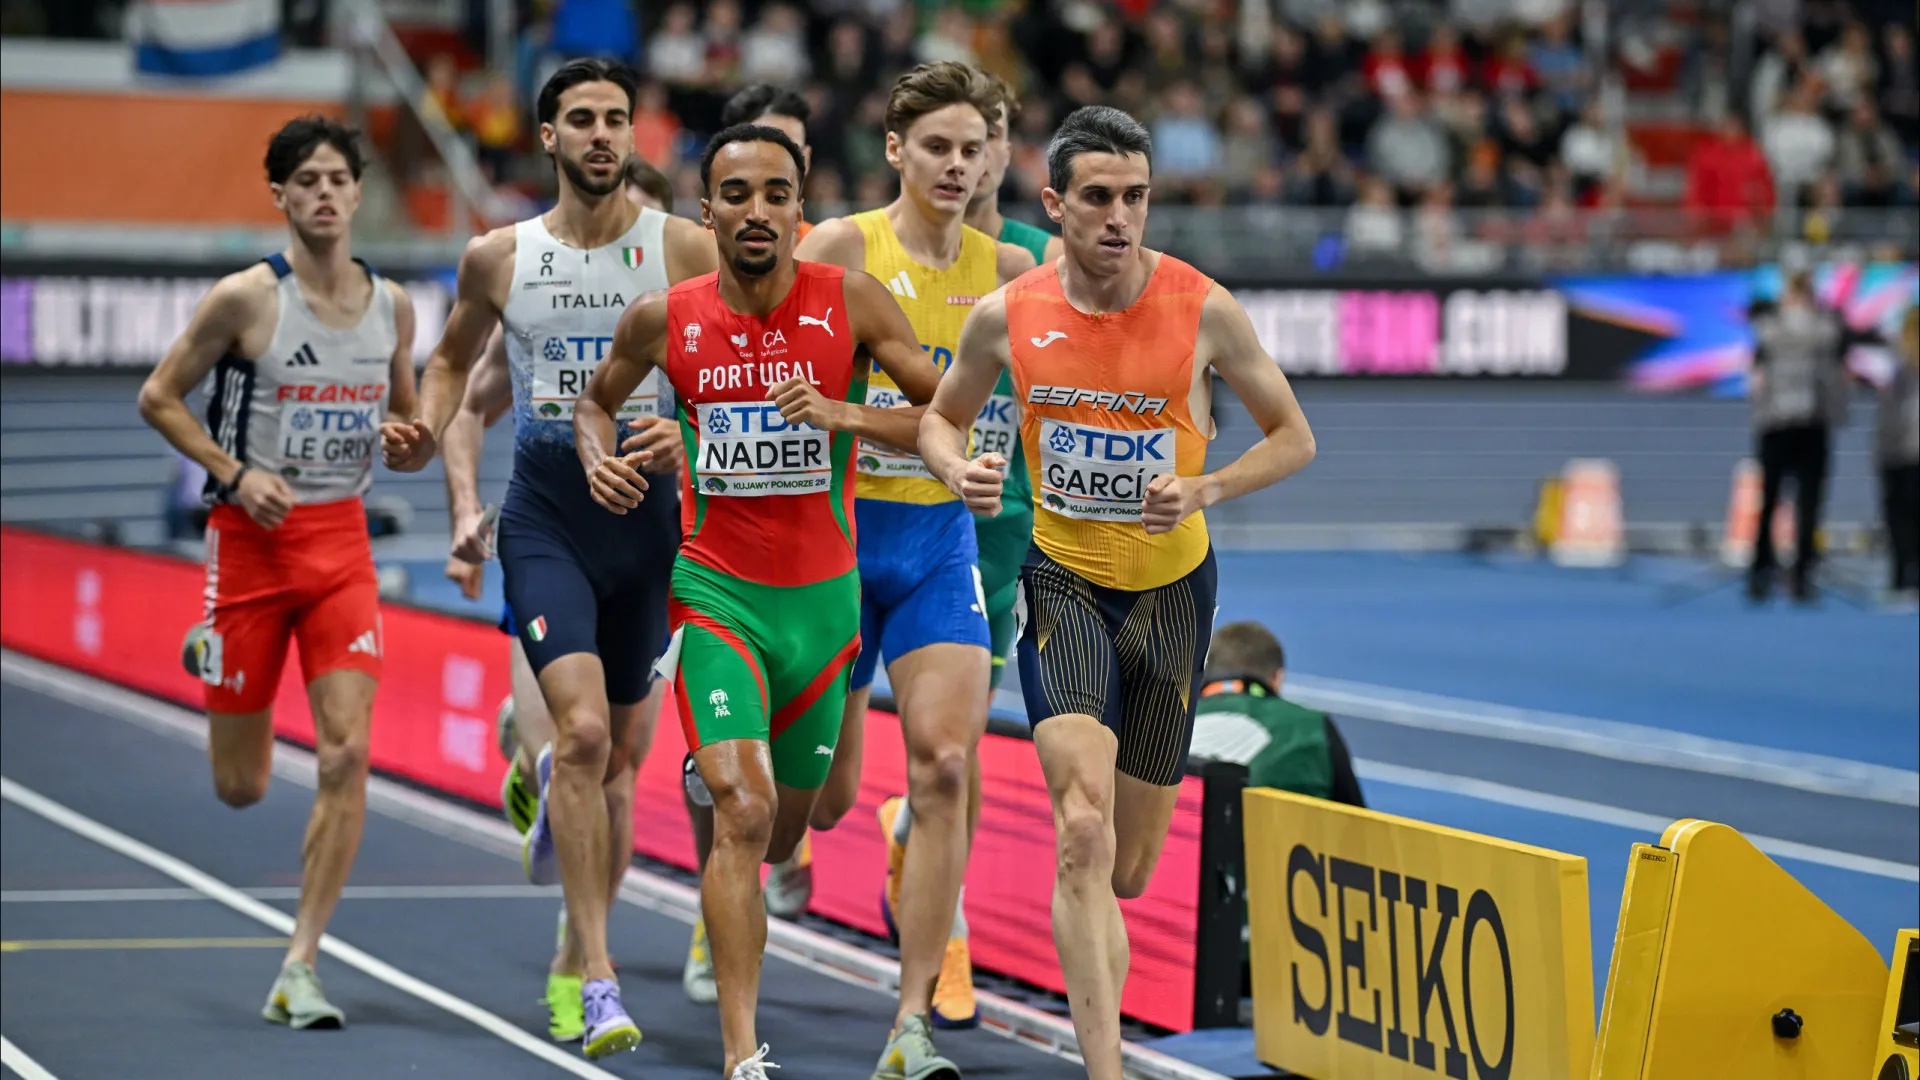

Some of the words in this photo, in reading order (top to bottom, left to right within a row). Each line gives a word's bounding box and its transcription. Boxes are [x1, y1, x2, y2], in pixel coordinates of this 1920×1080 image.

[552, 293, 626, 309] ITALIA
[947, 295, 980, 304] BAUHA
[567, 336, 614, 361] TD
[685, 344, 698, 353] FPA
[762, 328, 787, 348] CA
[559, 370, 592, 395] RI
[698, 361, 821, 393] PORTUGAL
[276, 383, 386, 403] FRANCE
[1028, 384, 1169, 416] ESPAÑA
[316, 408, 374, 432] TDK
[284, 437, 317, 460] LE
[324, 437, 376, 462] GRIX
[973, 428, 1009, 454] CER
[1075, 429, 1166, 462] TDK
[705, 438, 822, 469] NADER
[733, 481, 769, 490] KUJAWY
[771, 479, 813, 489] POMORZE
[815, 478, 826, 486] 26
[1070, 504, 1108, 514] KUJAWY
[1109, 507, 1143, 516] POMOR
[715, 709, 731, 719] FPA
[1641, 853, 1667, 863] SEIKO
[1286, 843, 1516, 1080] SEIKO
